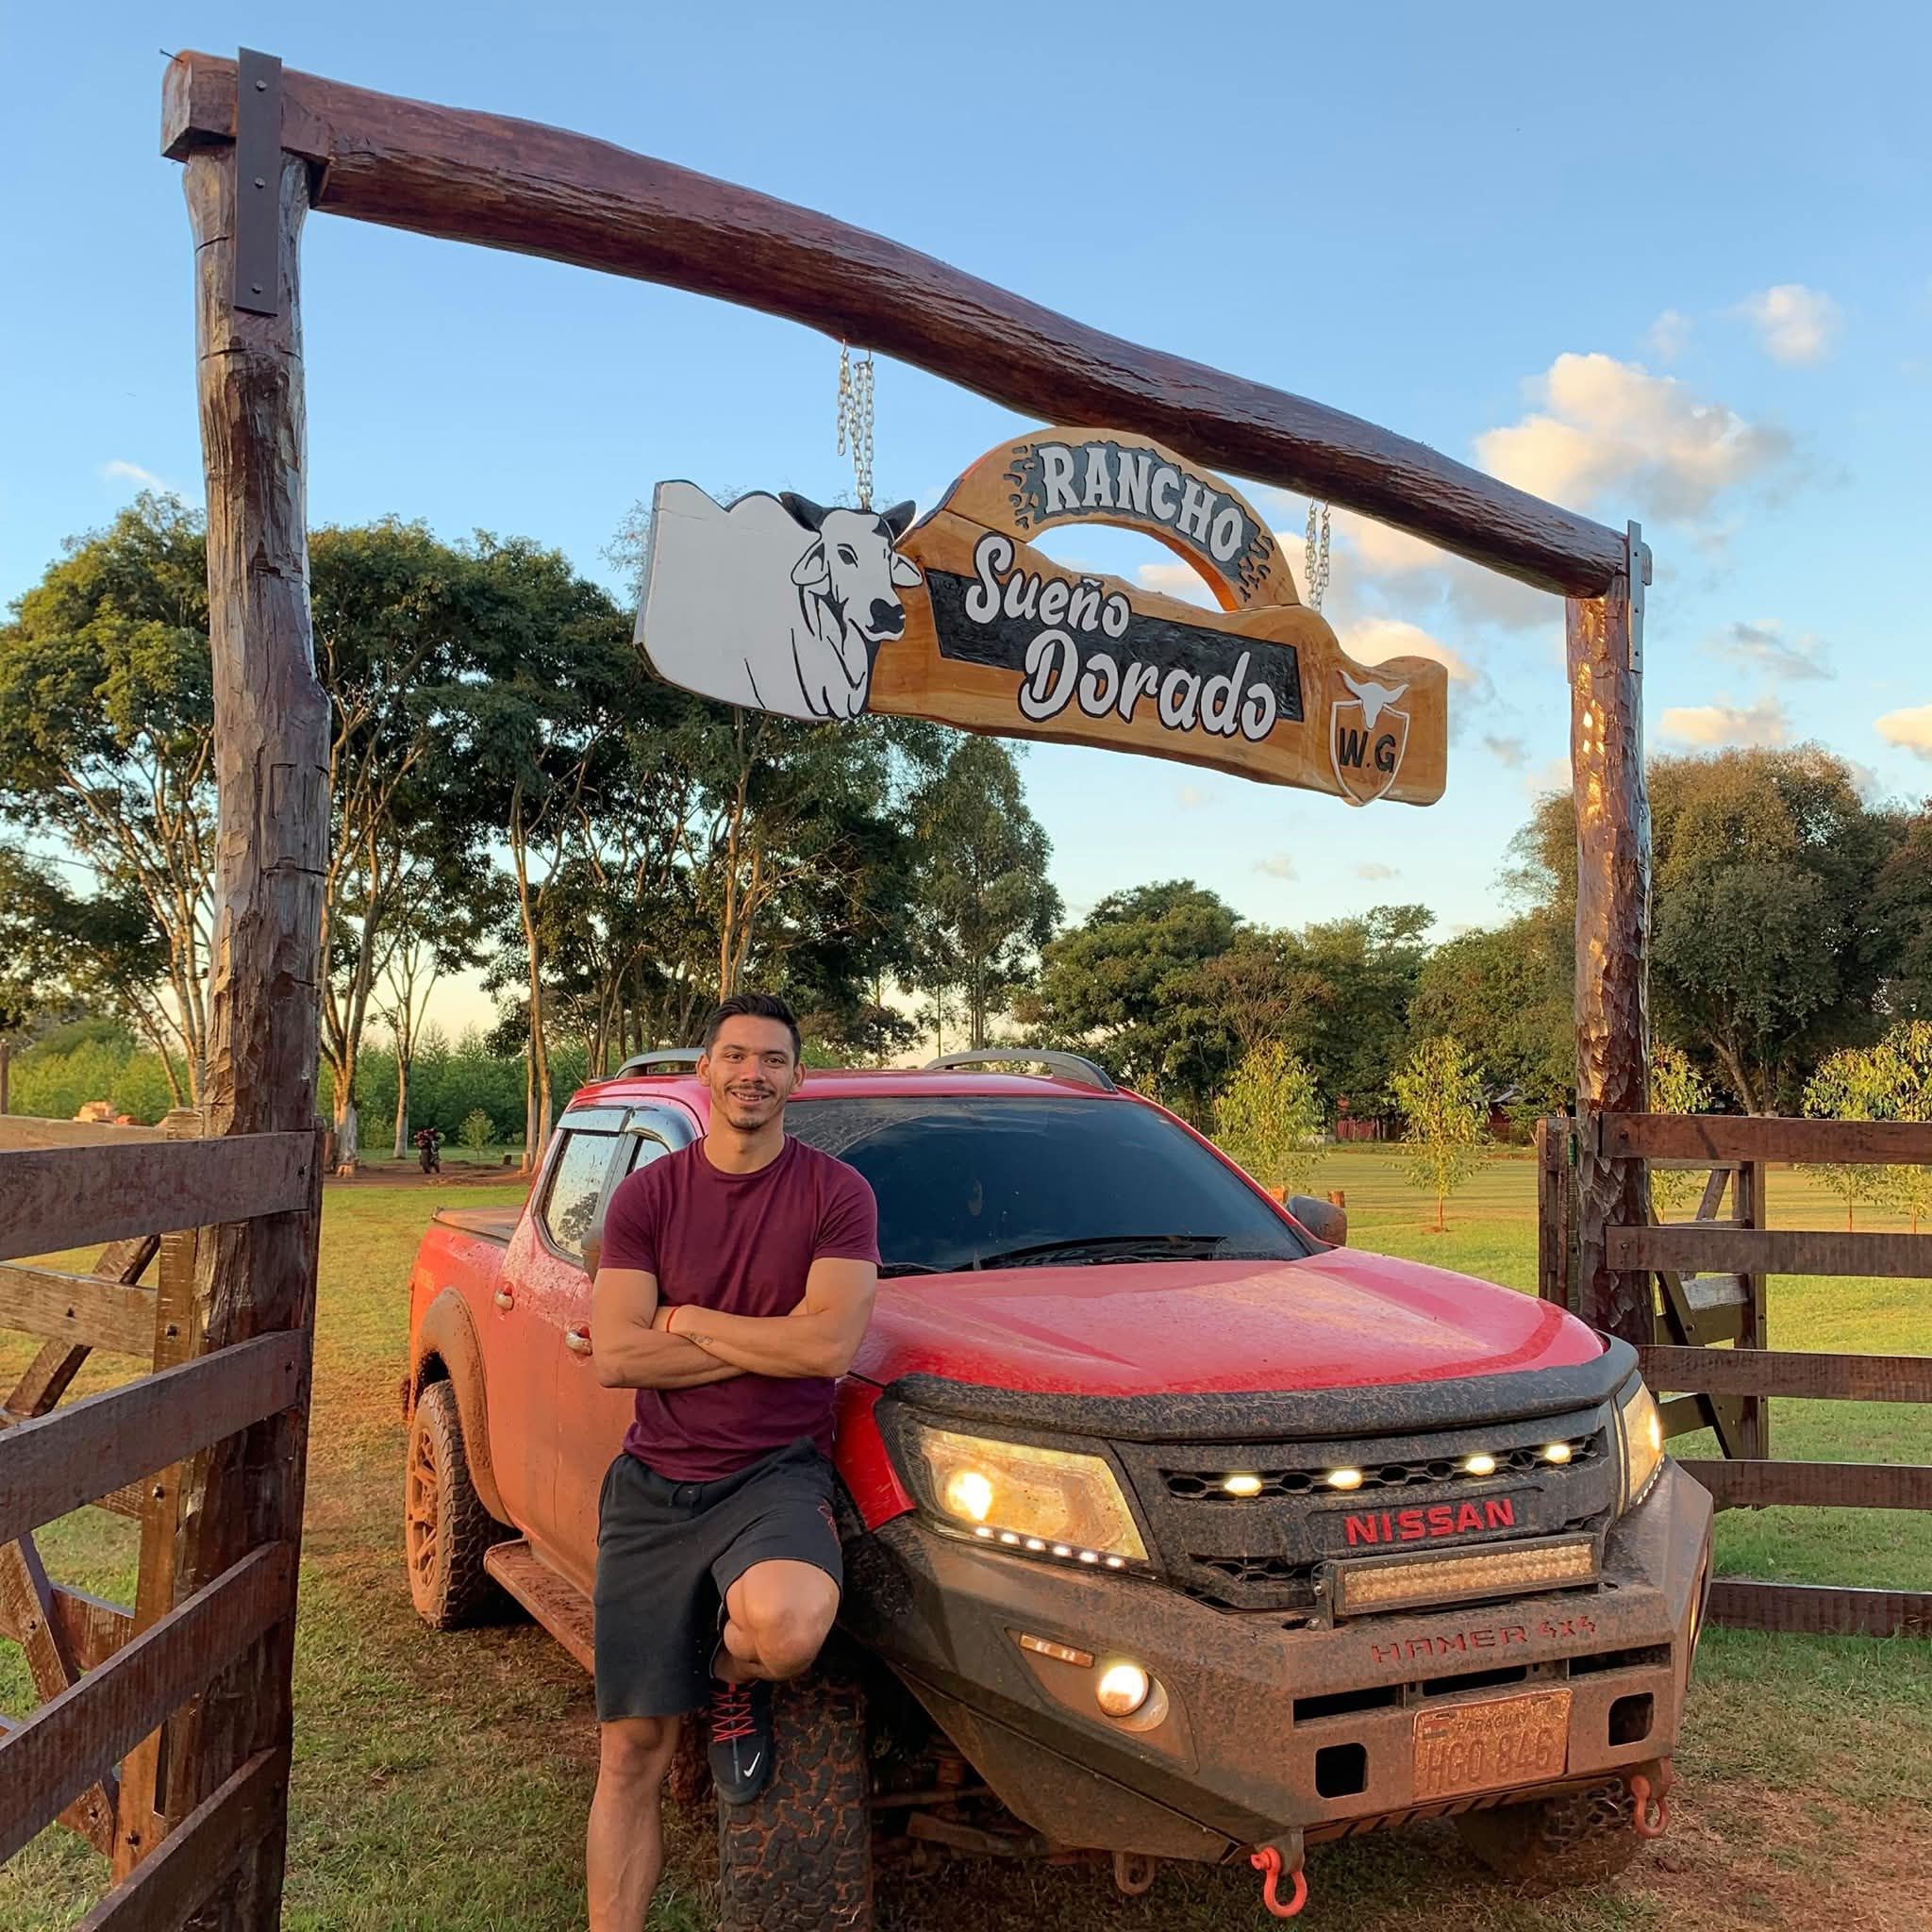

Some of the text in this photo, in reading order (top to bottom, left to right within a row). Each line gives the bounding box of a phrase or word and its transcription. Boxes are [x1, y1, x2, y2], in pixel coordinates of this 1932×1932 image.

[1039, 447, 1243, 562] RANCHO
[965, 535, 1129, 638] Sueño
[1021, 629, 1275, 741] Dorado
[1340, 727, 1396, 773] W.G
[1345, 1499, 1515, 1546] NISSAN
[1371, 1625, 1527, 1662] HAMER
[1457, 1713, 1527, 1734] PARAGUAY
[1496, 1725, 1554, 1778] 846
